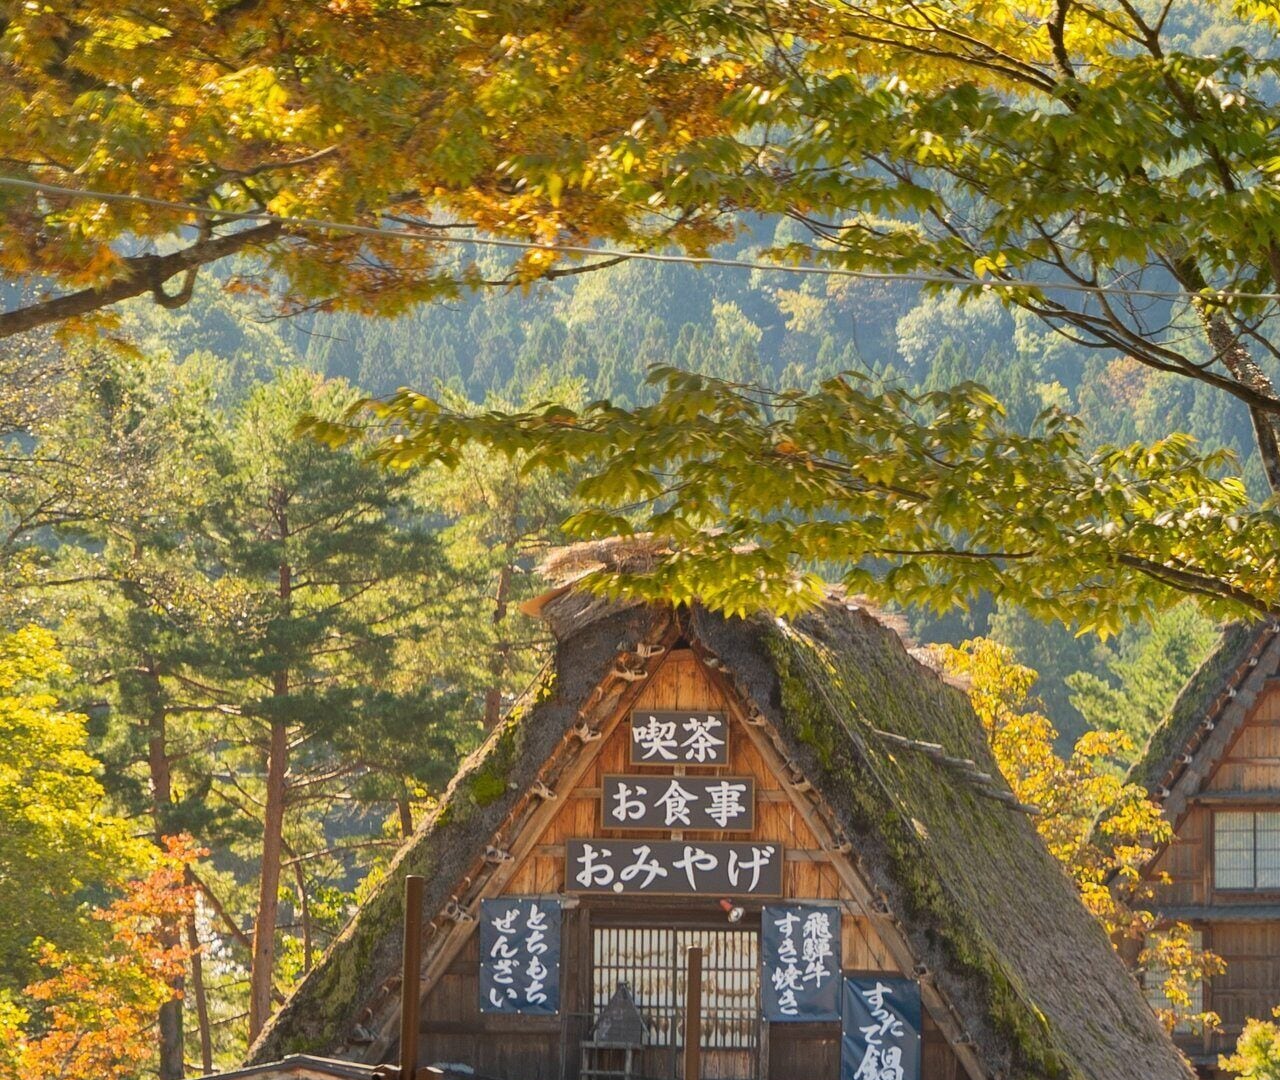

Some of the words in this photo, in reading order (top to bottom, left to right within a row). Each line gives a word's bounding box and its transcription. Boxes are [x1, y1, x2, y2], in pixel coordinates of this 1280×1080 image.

[633, 716, 725, 762] 喫茶
[612, 781, 747, 827] お食事
[576, 844, 775, 893] おみやげ
[490, 909, 520, 1007] ぜんざい
[525, 904, 548, 1004] とちもち
[772, 912, 804, 1015] すき焼き
[802, 912, 833, 988] 飛騨牛
